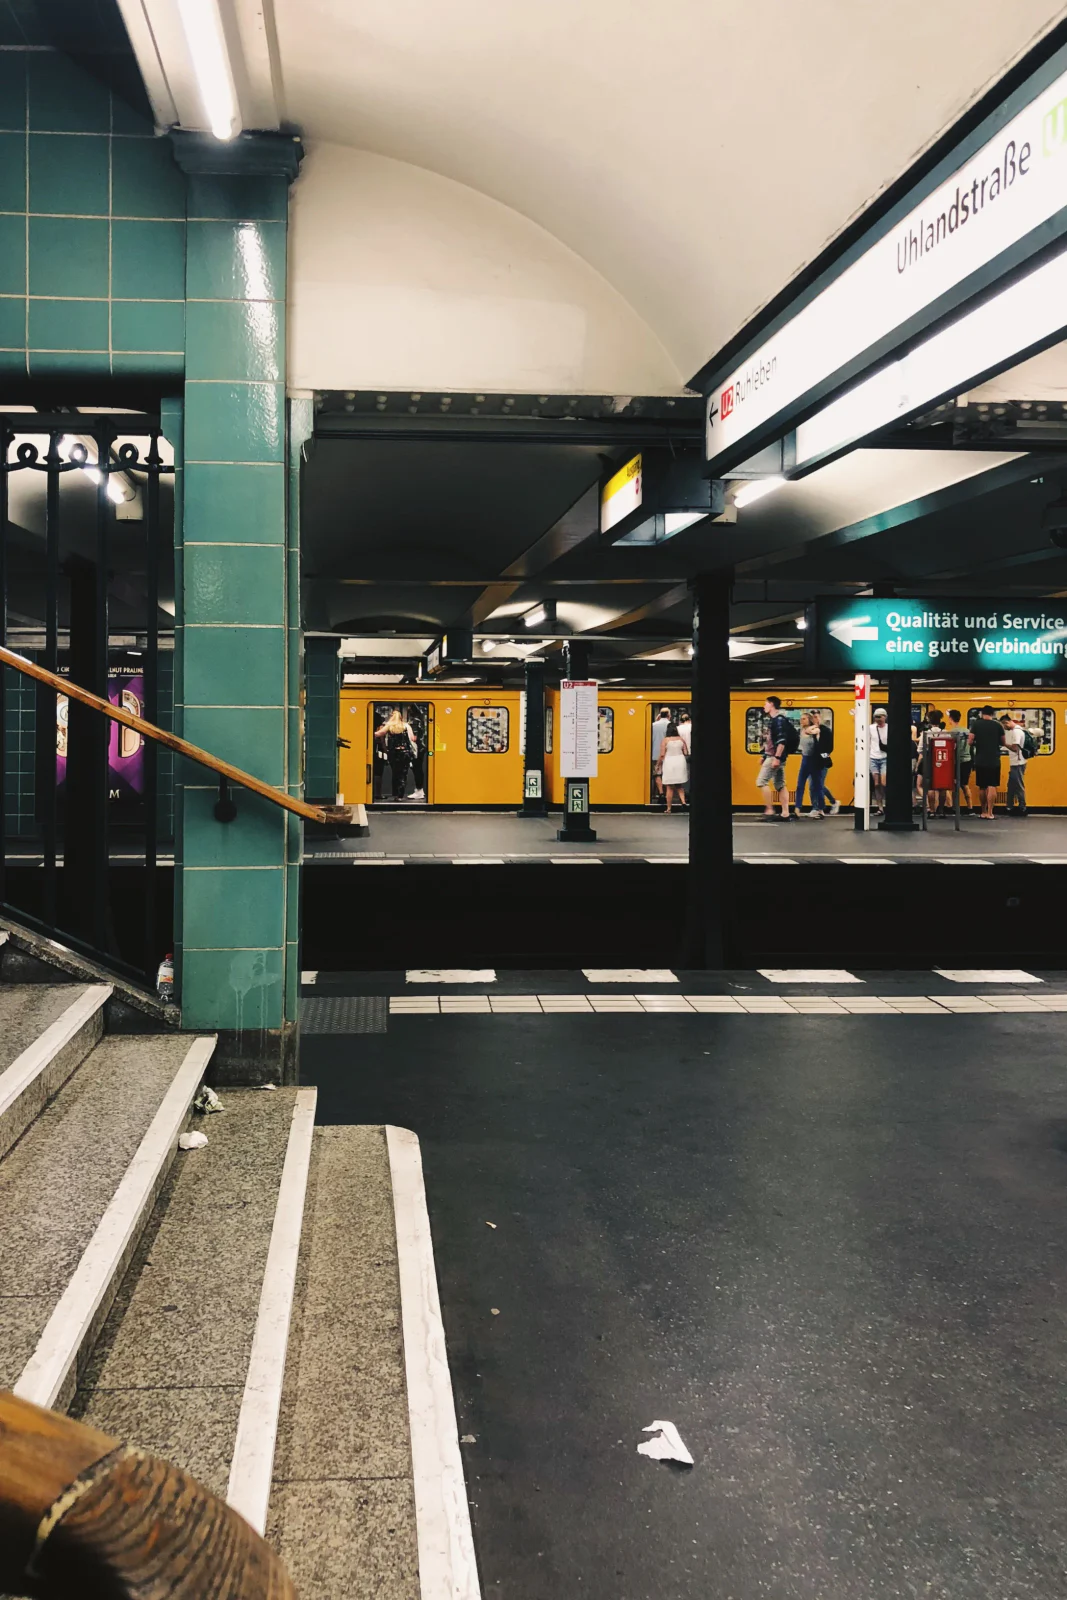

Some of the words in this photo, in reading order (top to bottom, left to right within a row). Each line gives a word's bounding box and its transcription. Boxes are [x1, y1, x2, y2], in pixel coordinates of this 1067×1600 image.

[897, 140, 1031, 274] Uhlandstraße
[721, 387, 733, 417] U2
[735, 356, 777, 407] Ruhleben
[886, 611, 959, 632] Qualität
[965, 612, 998, 629] und
[1003, 613, 1064, 629] Service
[886, 636, 924, 653] eine
[928, 639, 969, 657] gute
